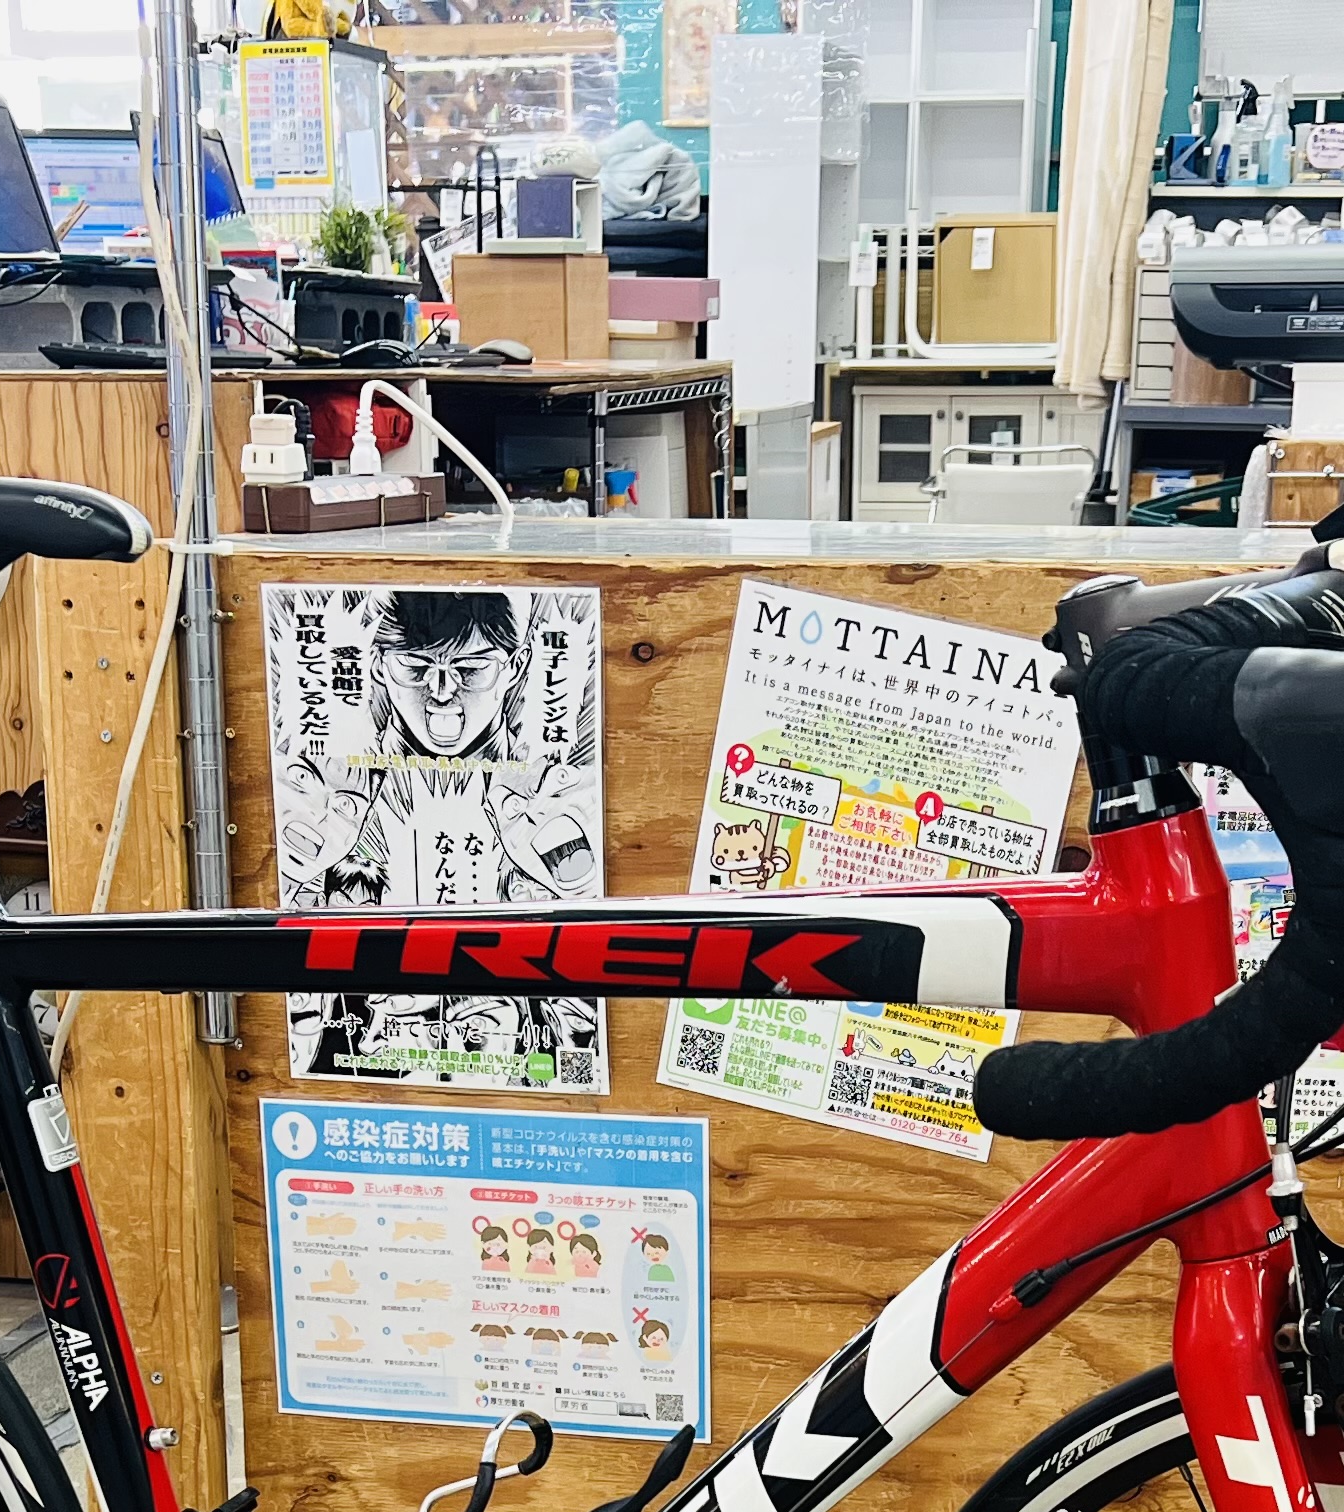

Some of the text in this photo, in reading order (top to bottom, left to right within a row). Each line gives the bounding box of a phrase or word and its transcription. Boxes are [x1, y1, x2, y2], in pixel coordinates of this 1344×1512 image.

[541, 630, 569, 743] 電子レンジは
[745, 670, 759, 684] It
[763, 674, 776, 689] is
[782, 681, 791, 692] a
[797, 684, 863, 708] message
[869, 697, 903, 717] from
[910, 706, 952, 728] Japan
[960, 719, 973, 731] to
[981, 723, 1004, 738] the
[757, 769, 815, 797] どんな物を
[733, 782, 830, 821] 買取ってくれるの?
[853, 802, 904, 825] お気軽に
[838, 815, 914, 844] ご相談下さい
[936, 811, 1034, 848] お店で売っている物は
[925, 828, 1032, 866] 全部買取したものだよ!
[278, 916, 864, 993] TREK
[739, 998, 807, 1025] LINE@
[736, 1014, 828, 1050] 友だち募集中。
[323, 1119, 471, 1153] 感染症対策
[490, 1126, 693, 1148] 新型コロナウイルスを含む感染症対策の
[890, 1116, 969, 1145] 0120-979-764
[324, 1149, 470, 1169] へのご協力をお願いします
[364, 1182, 445, 1197] 正しい手の洗い方
[547, 1193, 637, 1209] 3つの咳エチケット
[471, 1299, 561, 1318] 正しいマスクの着用
[49, 1316, 80, 1391] ALUMINUM
[60, 1323, 110, 1412] ALPHA
[490, 1379, 532, 1391] 首相官邸
[562, 1386, 627, 1400] 詳しい情報はこちら
[489, 1396, 526, 1409] 厚生労働省
[560, 1399, 590, 1412] 厚労省
